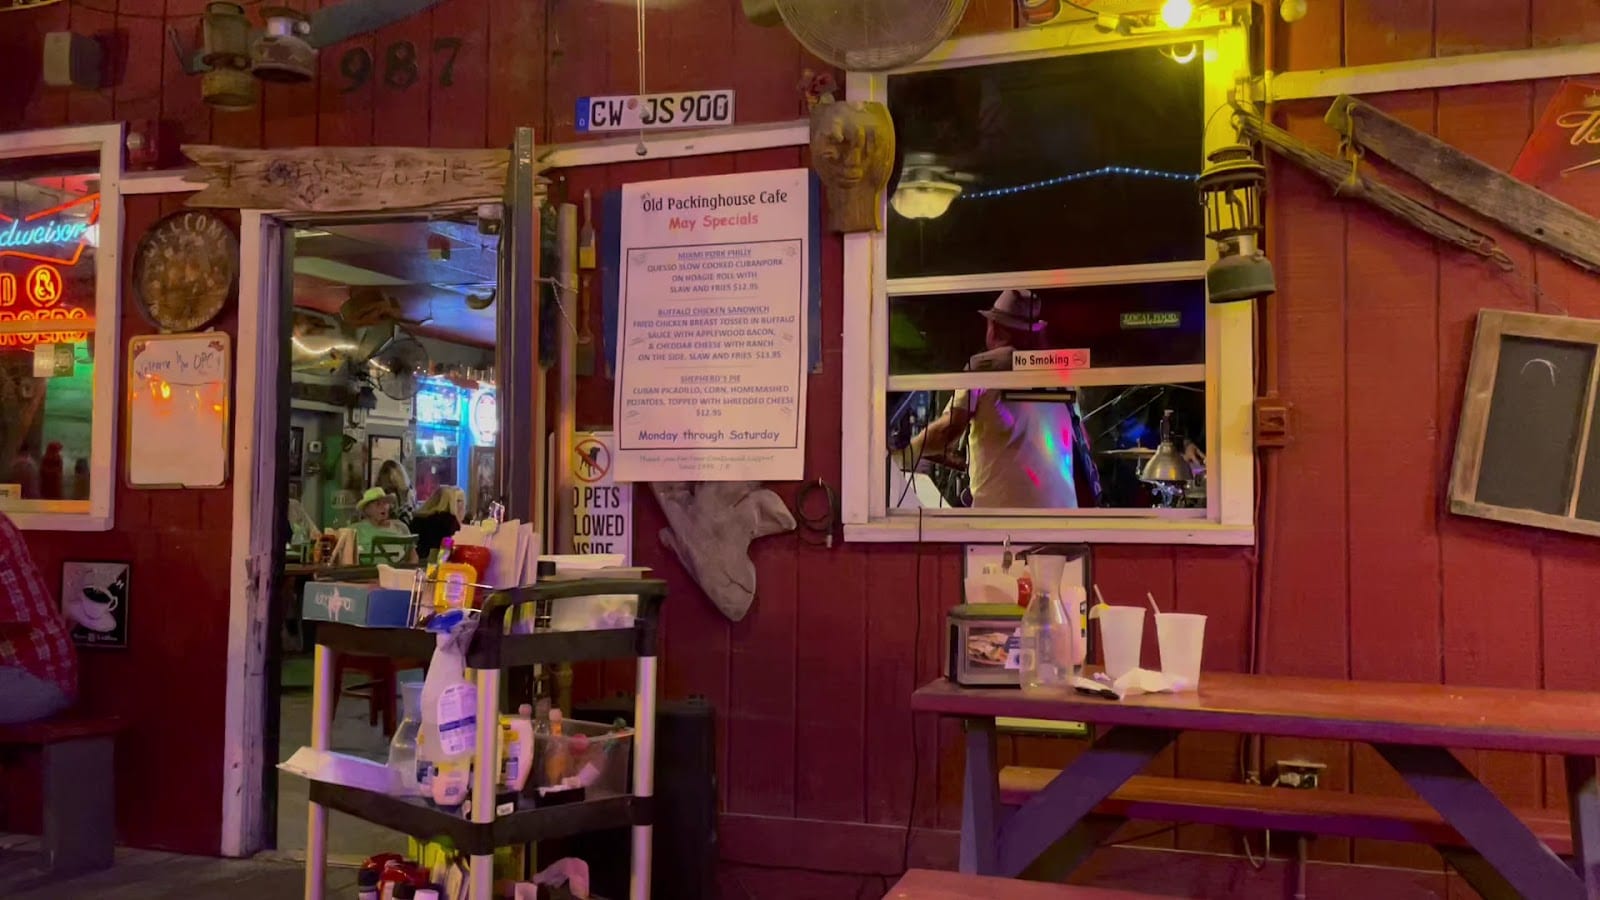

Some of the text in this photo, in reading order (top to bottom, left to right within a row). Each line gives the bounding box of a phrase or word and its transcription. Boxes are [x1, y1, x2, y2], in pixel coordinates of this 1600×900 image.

[591, 100, 624, 127] CW
[680, 94, 729, 122] 900
[643, 189, 788, 212] Old Packinghouse Cafe
[669, 212, 759, 231] May Specials
[678, 249, 752, 260] MIAMI PORK PHILLY
[678, 263, 700, 271] SLOW
[702, 261, 734, 270] COOKED
[671, 271, 758, 282] ON HOAGIE ROLL WITH
[670, 285, 691, 294] SLAW
[692, 284, 709, 292] AND
[710, 283, 732, 292] FRIES
[657, 306, 770, 317] BUFFALO CHICKEN SANDWICH
[633, 315, 795, 328] FRIED CHICKEN BREAST TOSSED IN BUFFALO
[648, 331, 671, 339] SAUCE
[674, 330, 694, 338] WITH
[695, 329, 745, 338] APPLEWOOD
[656, 342, 693, 350] CHEDDAR
[694, 341, 721, 350] CHEESE
[723, 340, 745, 348] WITH
[746, 339, 774, 348] RANCH
[638, 353, 651, 361] ON
[652, 353, 666, 361] THE
[689, 351, 711, 360] SLAW
[711, 351, 730, 360] AND
[1014, 354, 1069, 368] No Smoking
[727, 374, 741, 383] PIE
[633, 386, 660, 395] CUBAN
[730, 385, 789, 393] HOMEMASHED
[668, 397, 698, 406] TOPPED
[699, 397, 721, 405] WITH
[722, 397, 764, 405] SHREDDED
[765, 396, 793, 405] CHEESE
[696, 408, 722, 417] $12.95
[638, 428, 780, 443] Monday through Saturday
[584, 486, 620, 509] PETS
